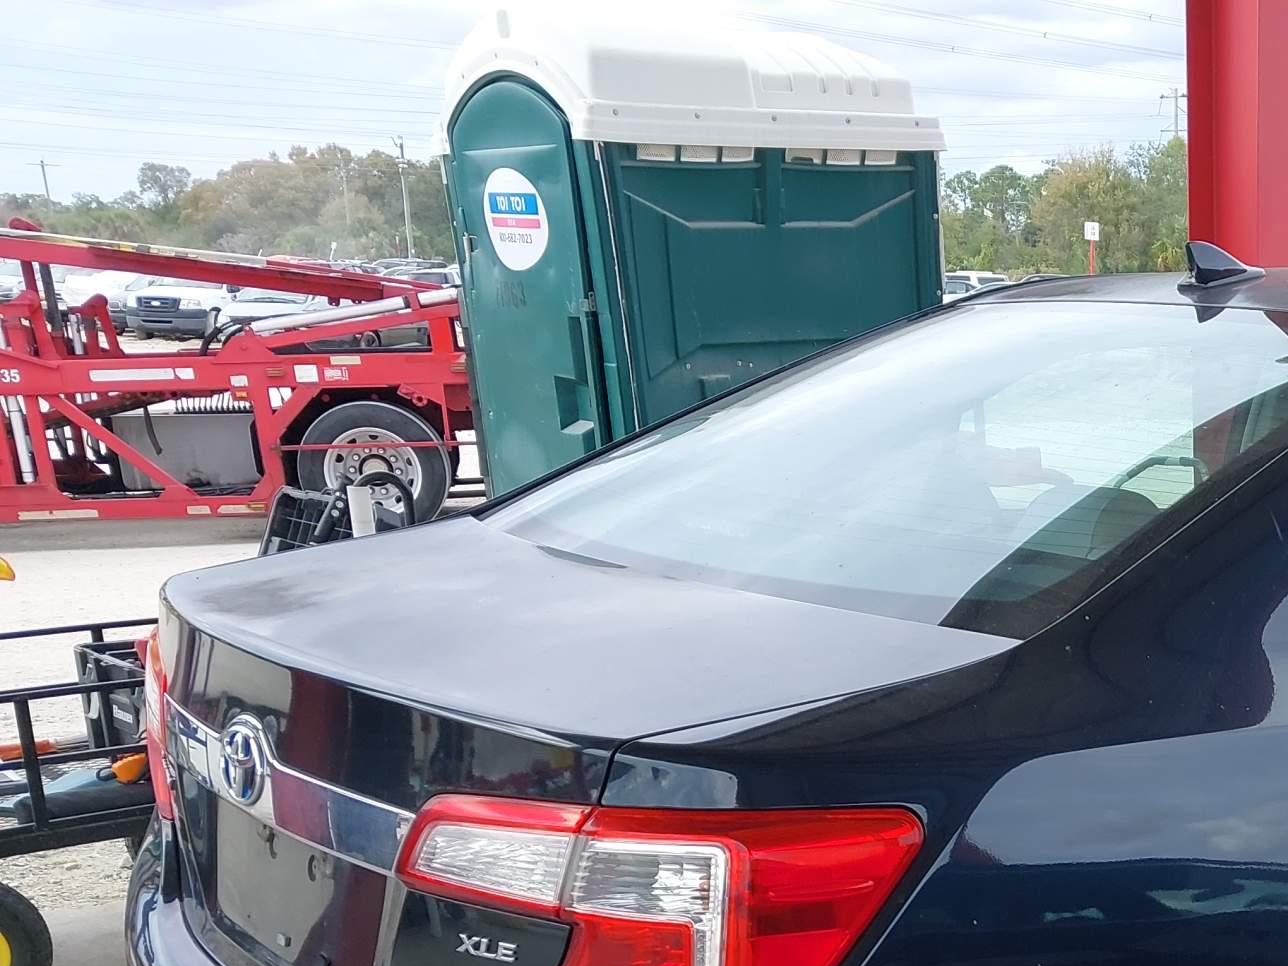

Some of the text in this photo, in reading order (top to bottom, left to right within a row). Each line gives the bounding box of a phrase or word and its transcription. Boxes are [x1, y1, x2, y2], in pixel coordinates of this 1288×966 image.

[495, 195, 526, 212] TOI TOI
[0, 368, 21, 383] 35
[455, 933, 516, 963] XLE
